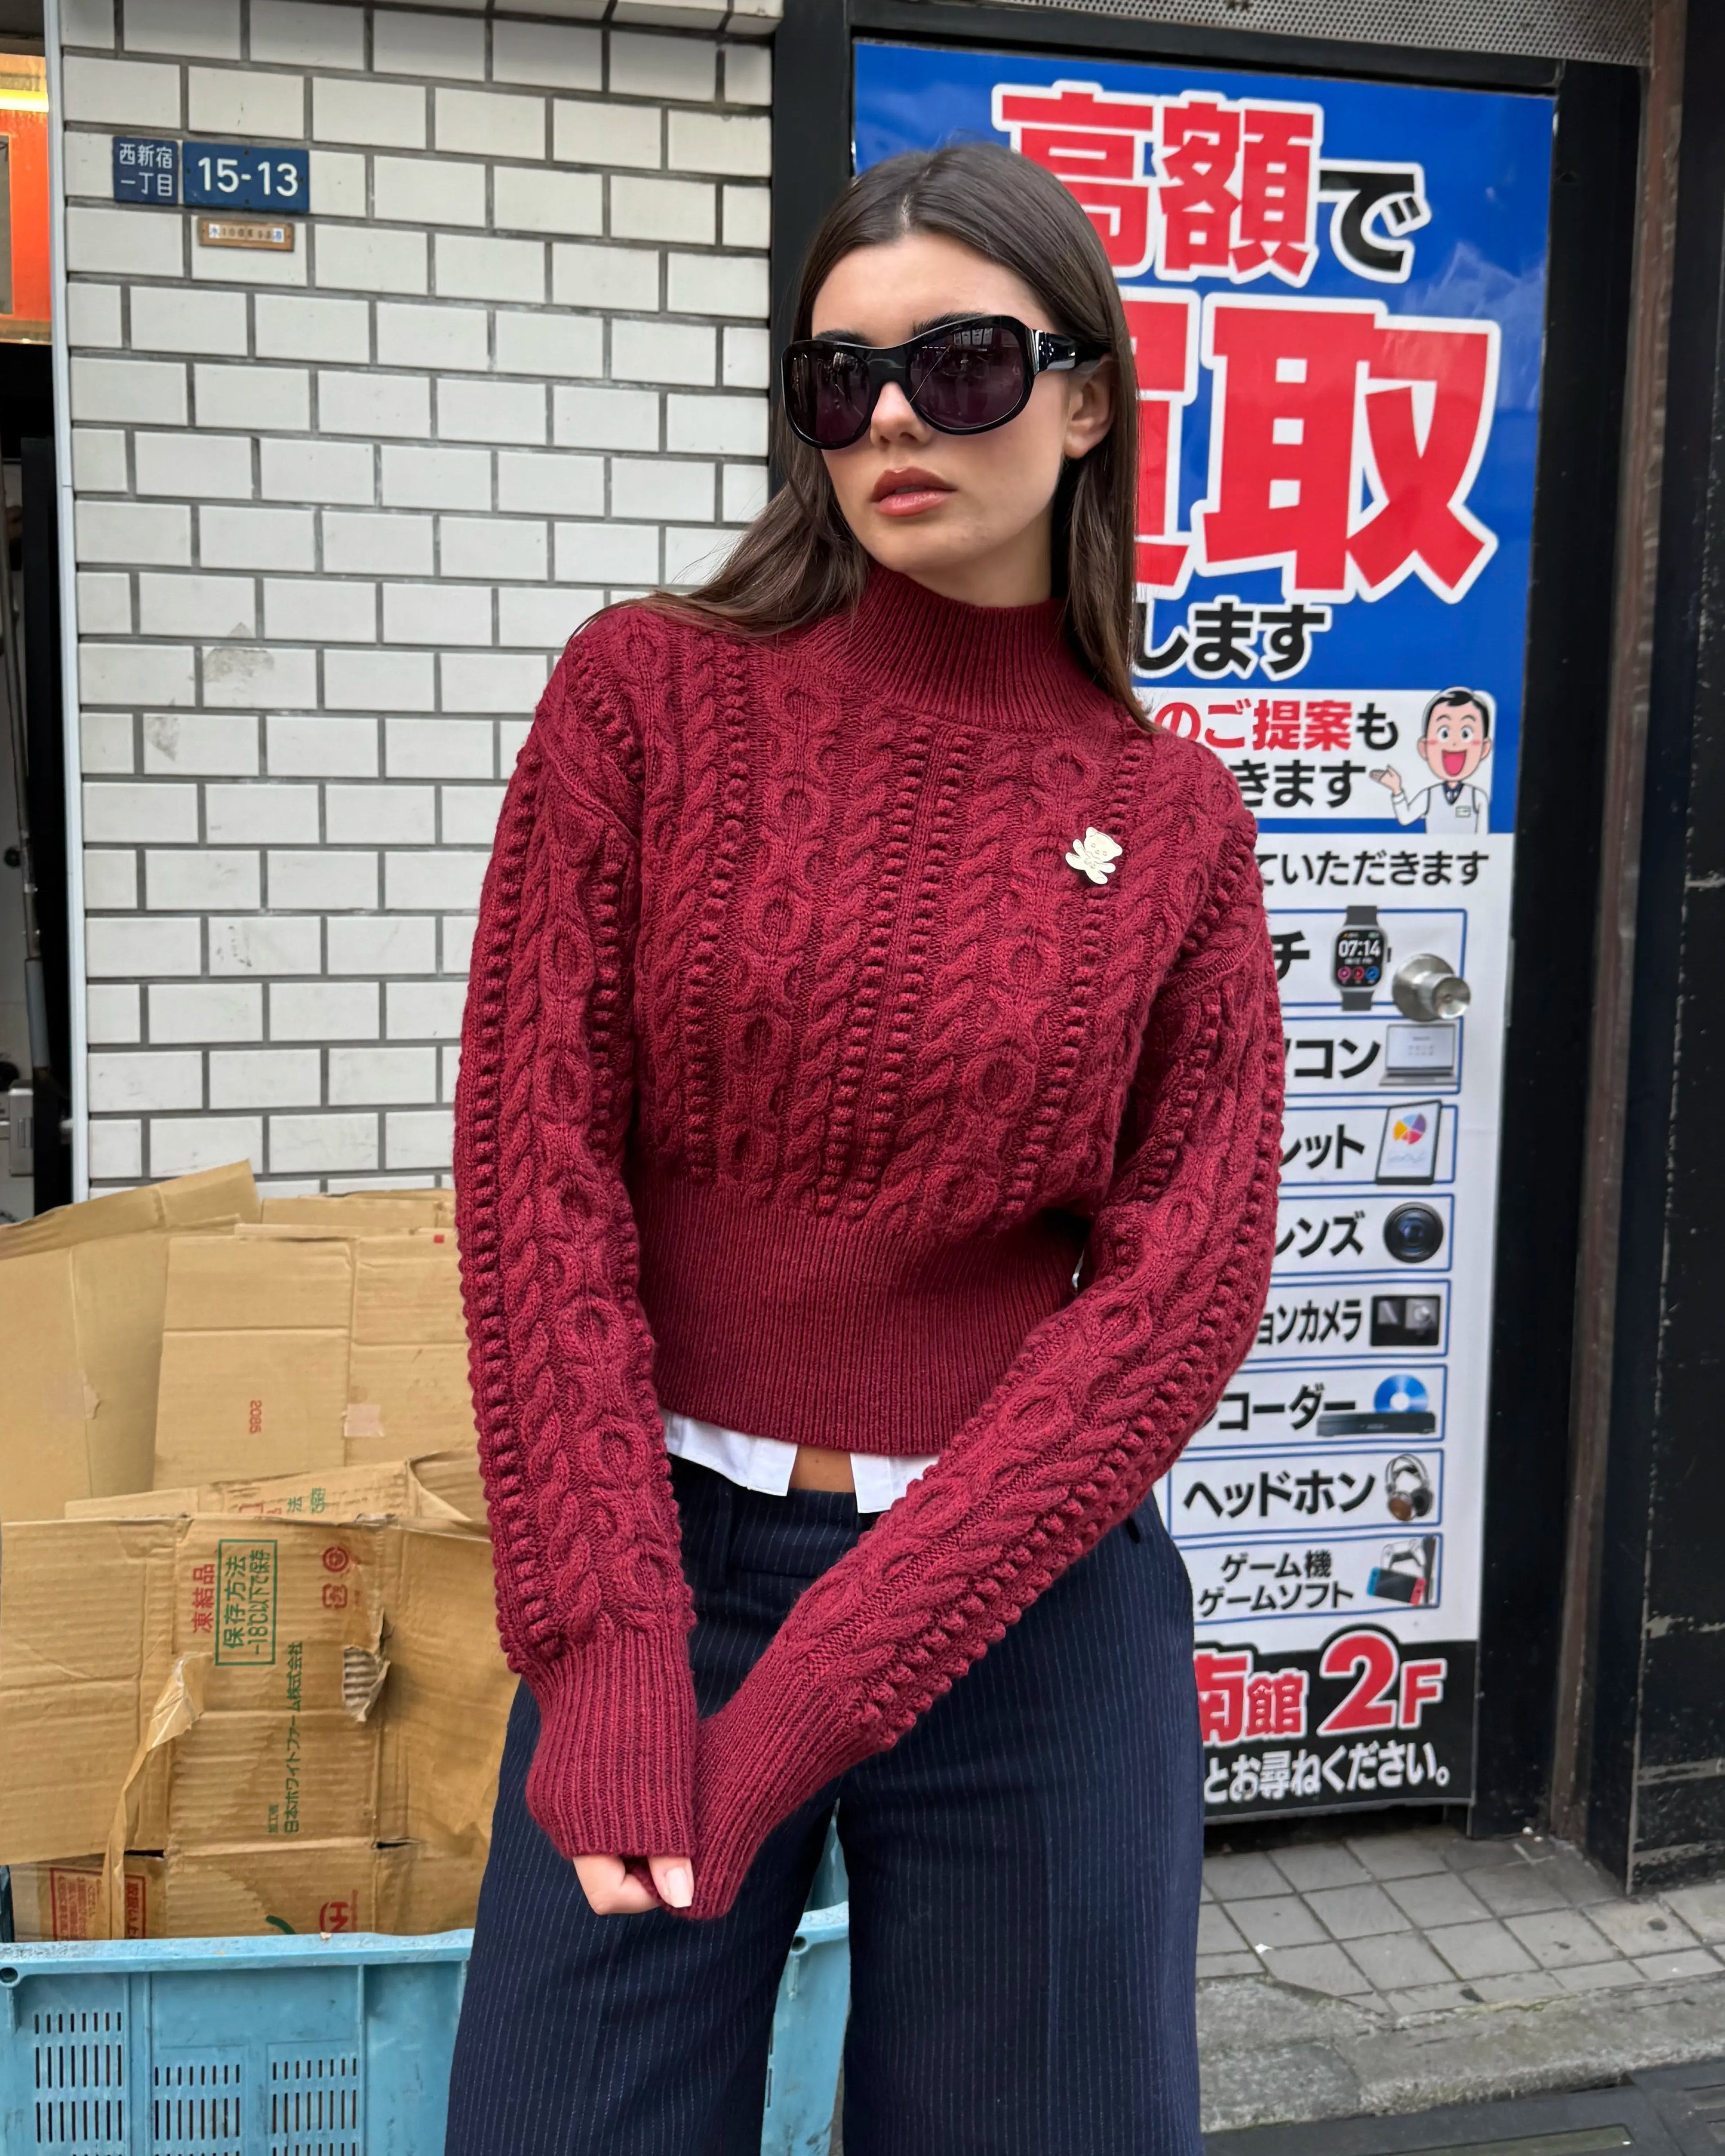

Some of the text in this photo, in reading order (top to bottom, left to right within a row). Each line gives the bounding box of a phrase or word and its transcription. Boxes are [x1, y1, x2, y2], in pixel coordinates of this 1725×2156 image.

[119, 143, 173, 169] 西新宿
[198, 157, 299, 197] 15-13
[120, 172, 173, 197] 一丁目
[1001, 90, 1423, 278] 高額で
[1135, 601, 1327, 673] します
[1137, 698, 1399, 752] のご提案も
[1228, 759, 1366, 808] きます
[1338, 939, 1381, 958] 07:14
[1284, 1038, 1381, 1079] コン
[1204, 1382, 1356, 1431] コーダー
[1183, 1469, 1376, 1518] ヘッドホン
[1221, 1549, 1332, 1583] ゲーム機
[191, 1564, 215, 1634] 凍結品
[222, 1556, 247, 1649] 保存方法
[1198, 1581, 1354, 1617] ゲームソフト
[1320, 1634, 1442, 1732] 2F
[284, 1641, 303, 1833] 日本ホワイトファーム株式会社
[1203, 1740, 1451, 1804] とお尋ねください。
